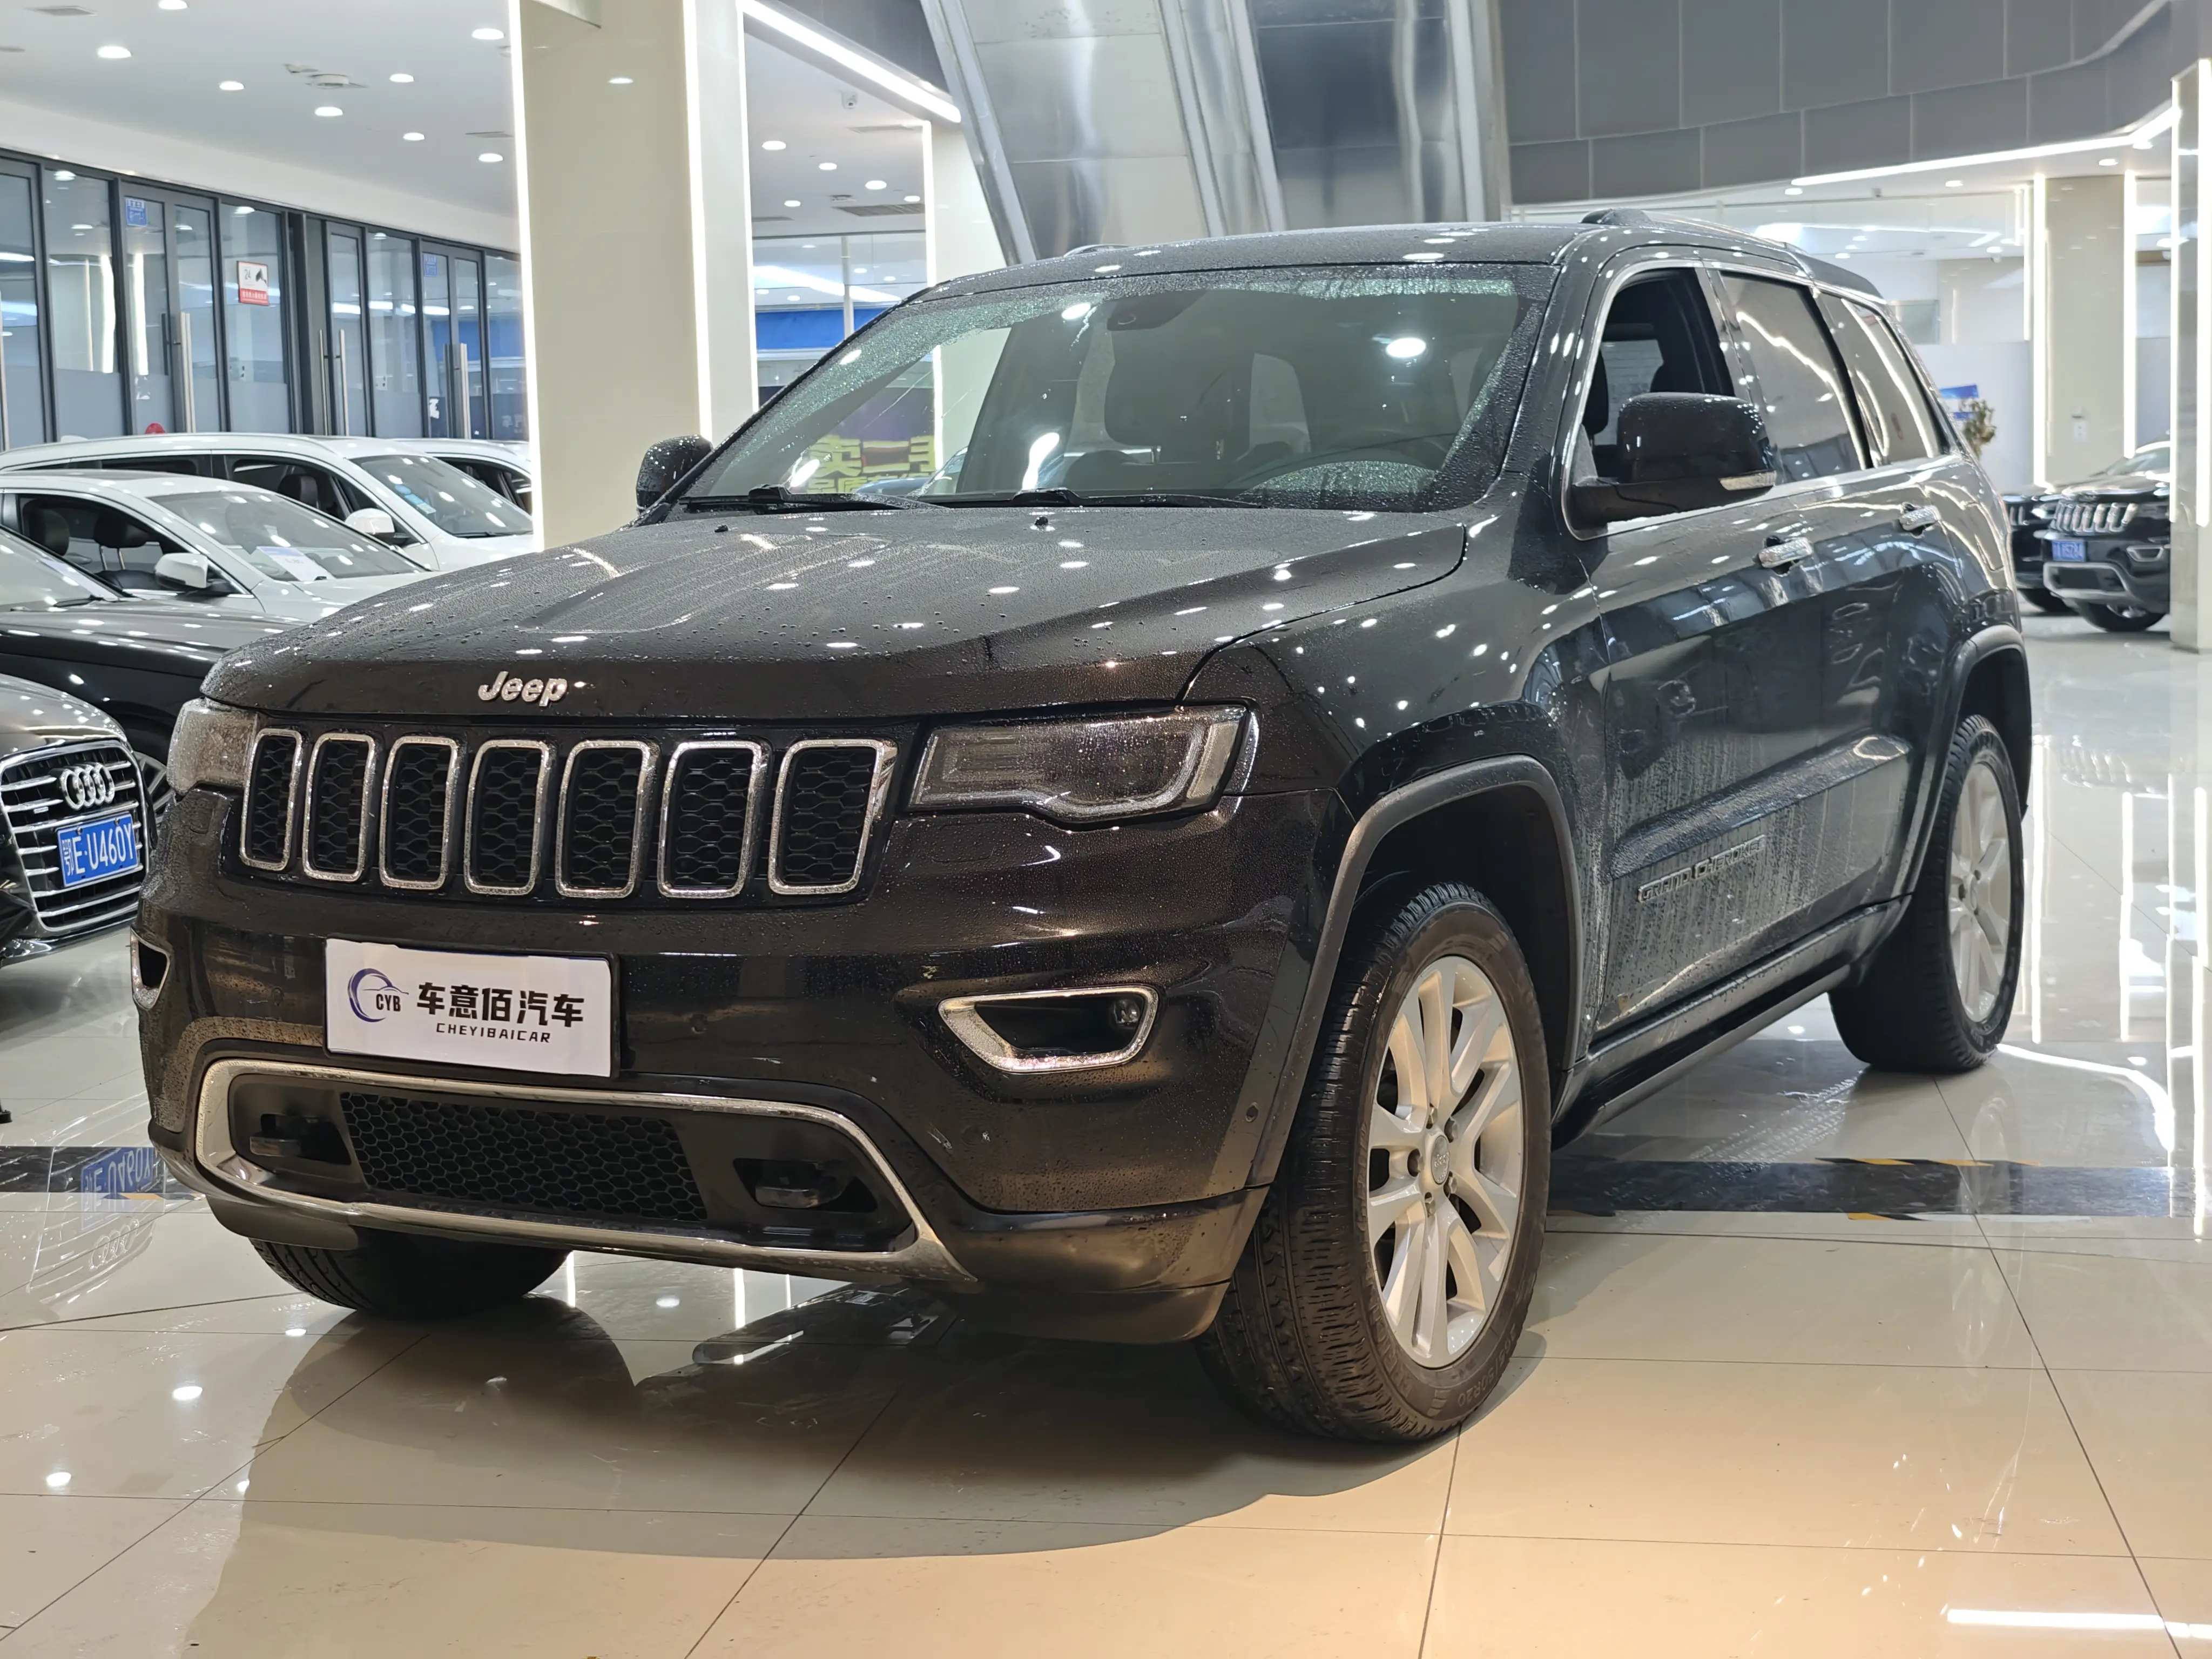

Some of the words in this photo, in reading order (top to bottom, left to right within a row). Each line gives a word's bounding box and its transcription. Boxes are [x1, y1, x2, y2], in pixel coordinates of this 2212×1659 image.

[478, 671, 567, 706] Jeep
[1637, 867, 1691, 903] GRAND
[376, 993, 401, 1012] CYB
[417, 982, 584, 1027] 车意佰汽车
[436, 1023, 550, 1043] CHEYIBAICAR
